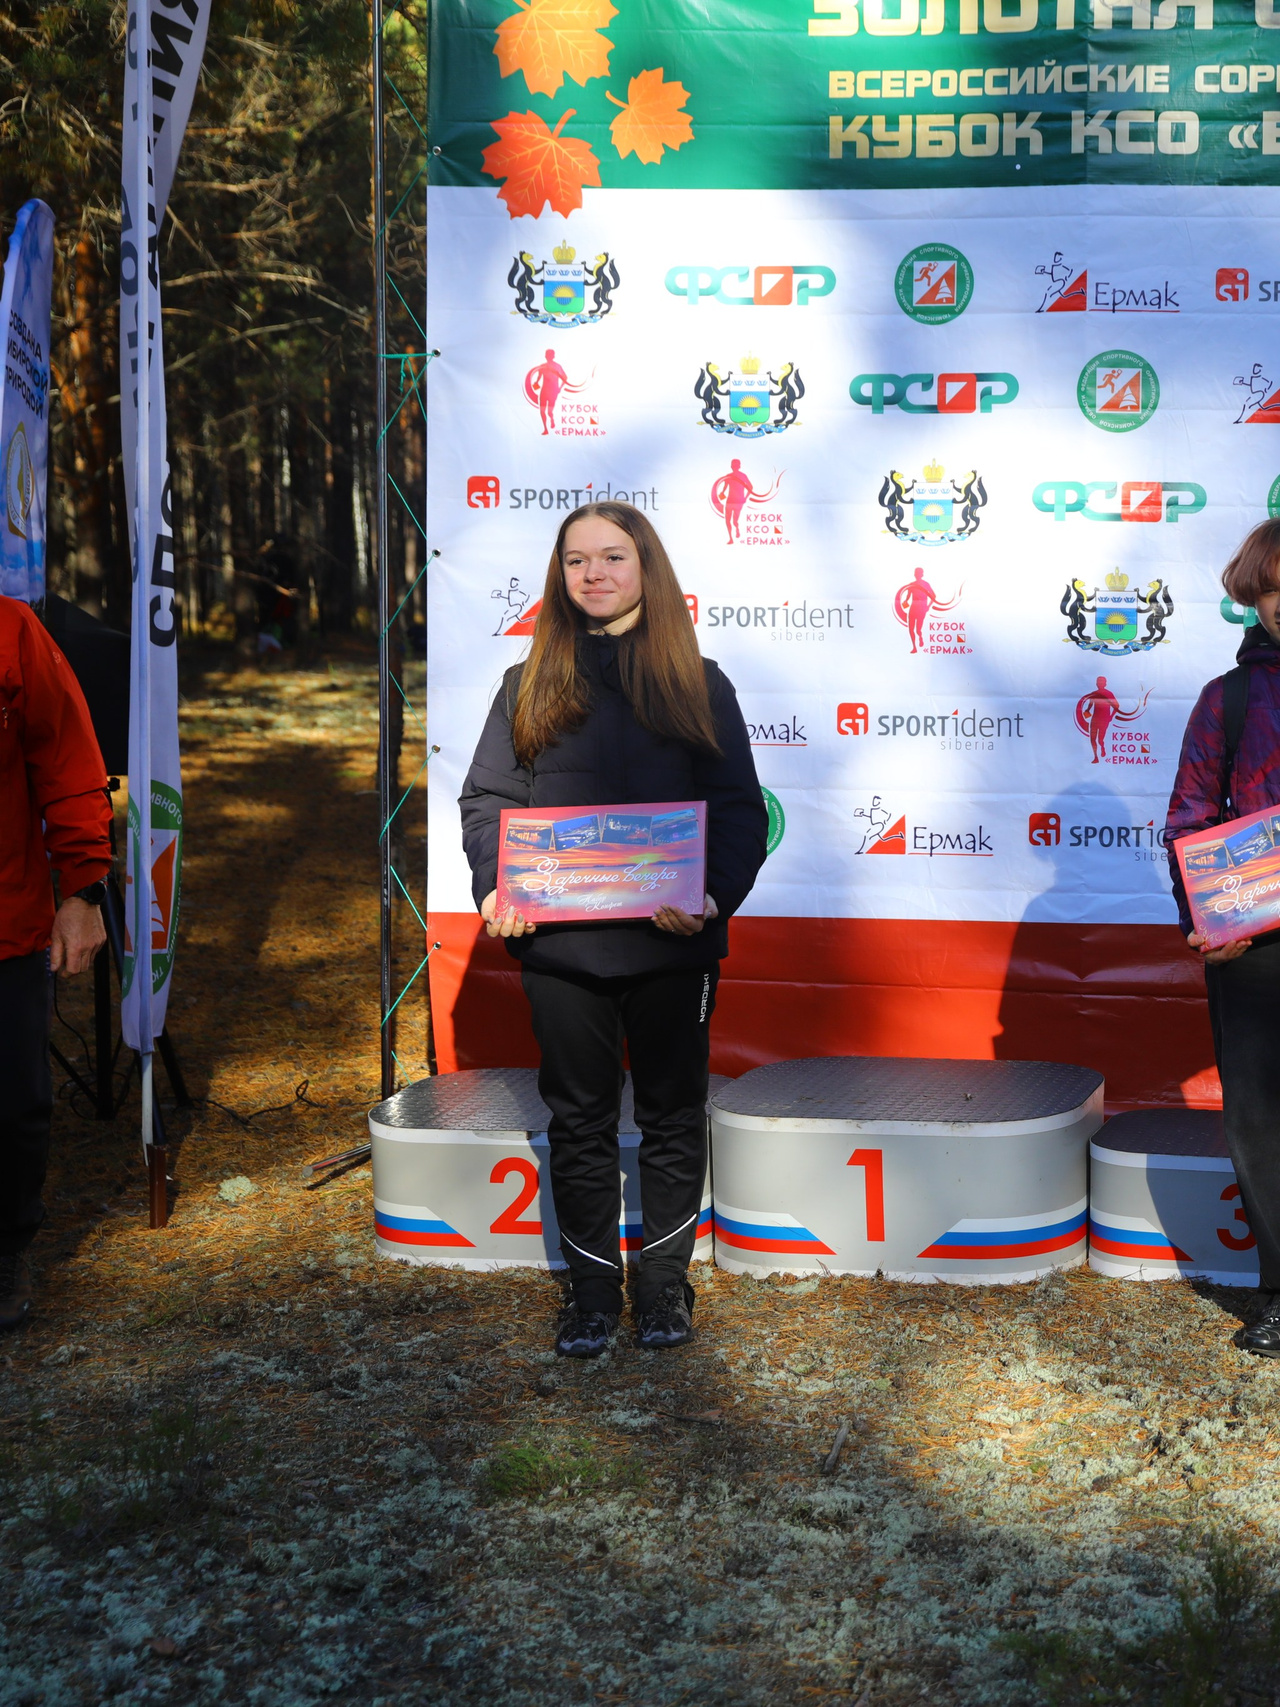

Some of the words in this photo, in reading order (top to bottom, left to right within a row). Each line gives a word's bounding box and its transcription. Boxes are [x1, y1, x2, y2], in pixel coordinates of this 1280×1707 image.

[828, 59, 1170, 98] ВСЕРОССИЙСКИЕ
[828, 111, 1043, 159] КУБОК
[1071, 109, 1200, 155] КСО
[899, 254, 917, 286] ФЕДЕРАЦИЯ
[920, 246, 959, 259] СПОРТИВНОГО
[1094, 281, 1180, 311] Ермак
[7, 337, 48, 396] ИБИРСКОЙ
[1081, 360, 1100, 392] ФЕДЕРАЦИЯ
[1102, 353, 1144, 367] СПОРТИВНОГО
[561, 403, 599, 414] КУБОК
[561, 415, 586, 425] КСО
[554, 426, 607, 437] «ЕРМАК»
[746, 513, 783, 523] КУБОК
[746, 525, 770, 534] КСО
[739, 536, 791, 546] «ЕРМАК»
[708, 600, 855, 629] SPORTident
[929, 622, 966, 632] КУБОК
[770, 628, 825, 642] siberia
[929, 633, 957, 643] КСО
[923, 644, 973, 655] «ЕРМАК»
[747, 715, 807, 746] мак
[878, 709, 1024, 738] SPORTident
[1111, 732, 1150, 742] КУБОК
[940, 738, 995, 751] siberia
[1111, 743, 1138, 753] КСО
[1105, 755, 1158, 765] «ЕРМАК»
[912, 825, 994, 857] Ермак
[1134, 849, 1167, 862] sibe
[523, 856, 620, 896] Заречные
[488, 1157, 541, 1234] 2
[846, 1148, 885, 1242] 1
[1216, 1182, 1258, 1250] 3
